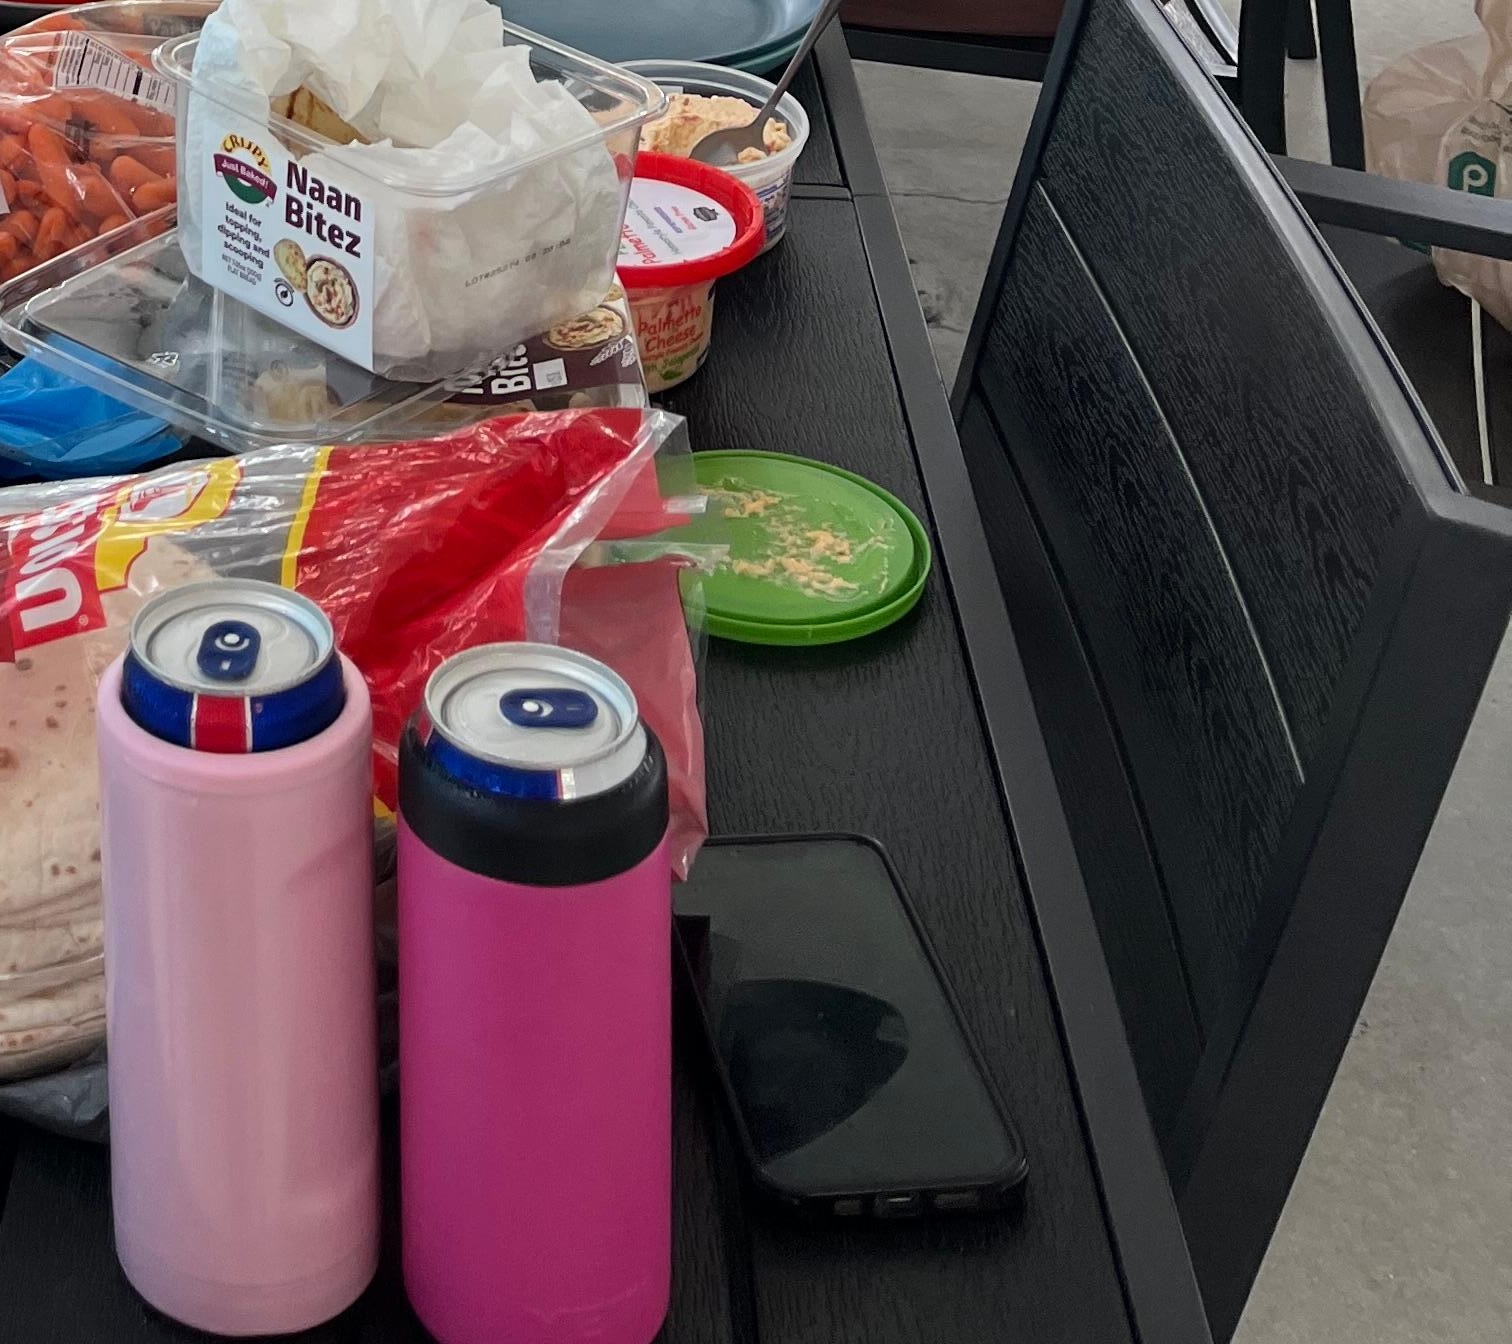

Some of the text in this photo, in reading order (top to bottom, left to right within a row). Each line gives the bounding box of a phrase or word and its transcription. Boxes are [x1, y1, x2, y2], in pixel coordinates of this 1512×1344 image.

[221, 159, 269, 189] Just Baked!
[287, 160, 361, 222] Naan
[225, 201, 262, 228] Ideal for
[225, 215, 262, 242] topping,
[285, 193, 361, 258] Bitez
[217, 224, 270, 259] dipping and
[223, 240, 264, 270] scooping
[644, 325, 696, 353] Cheese
